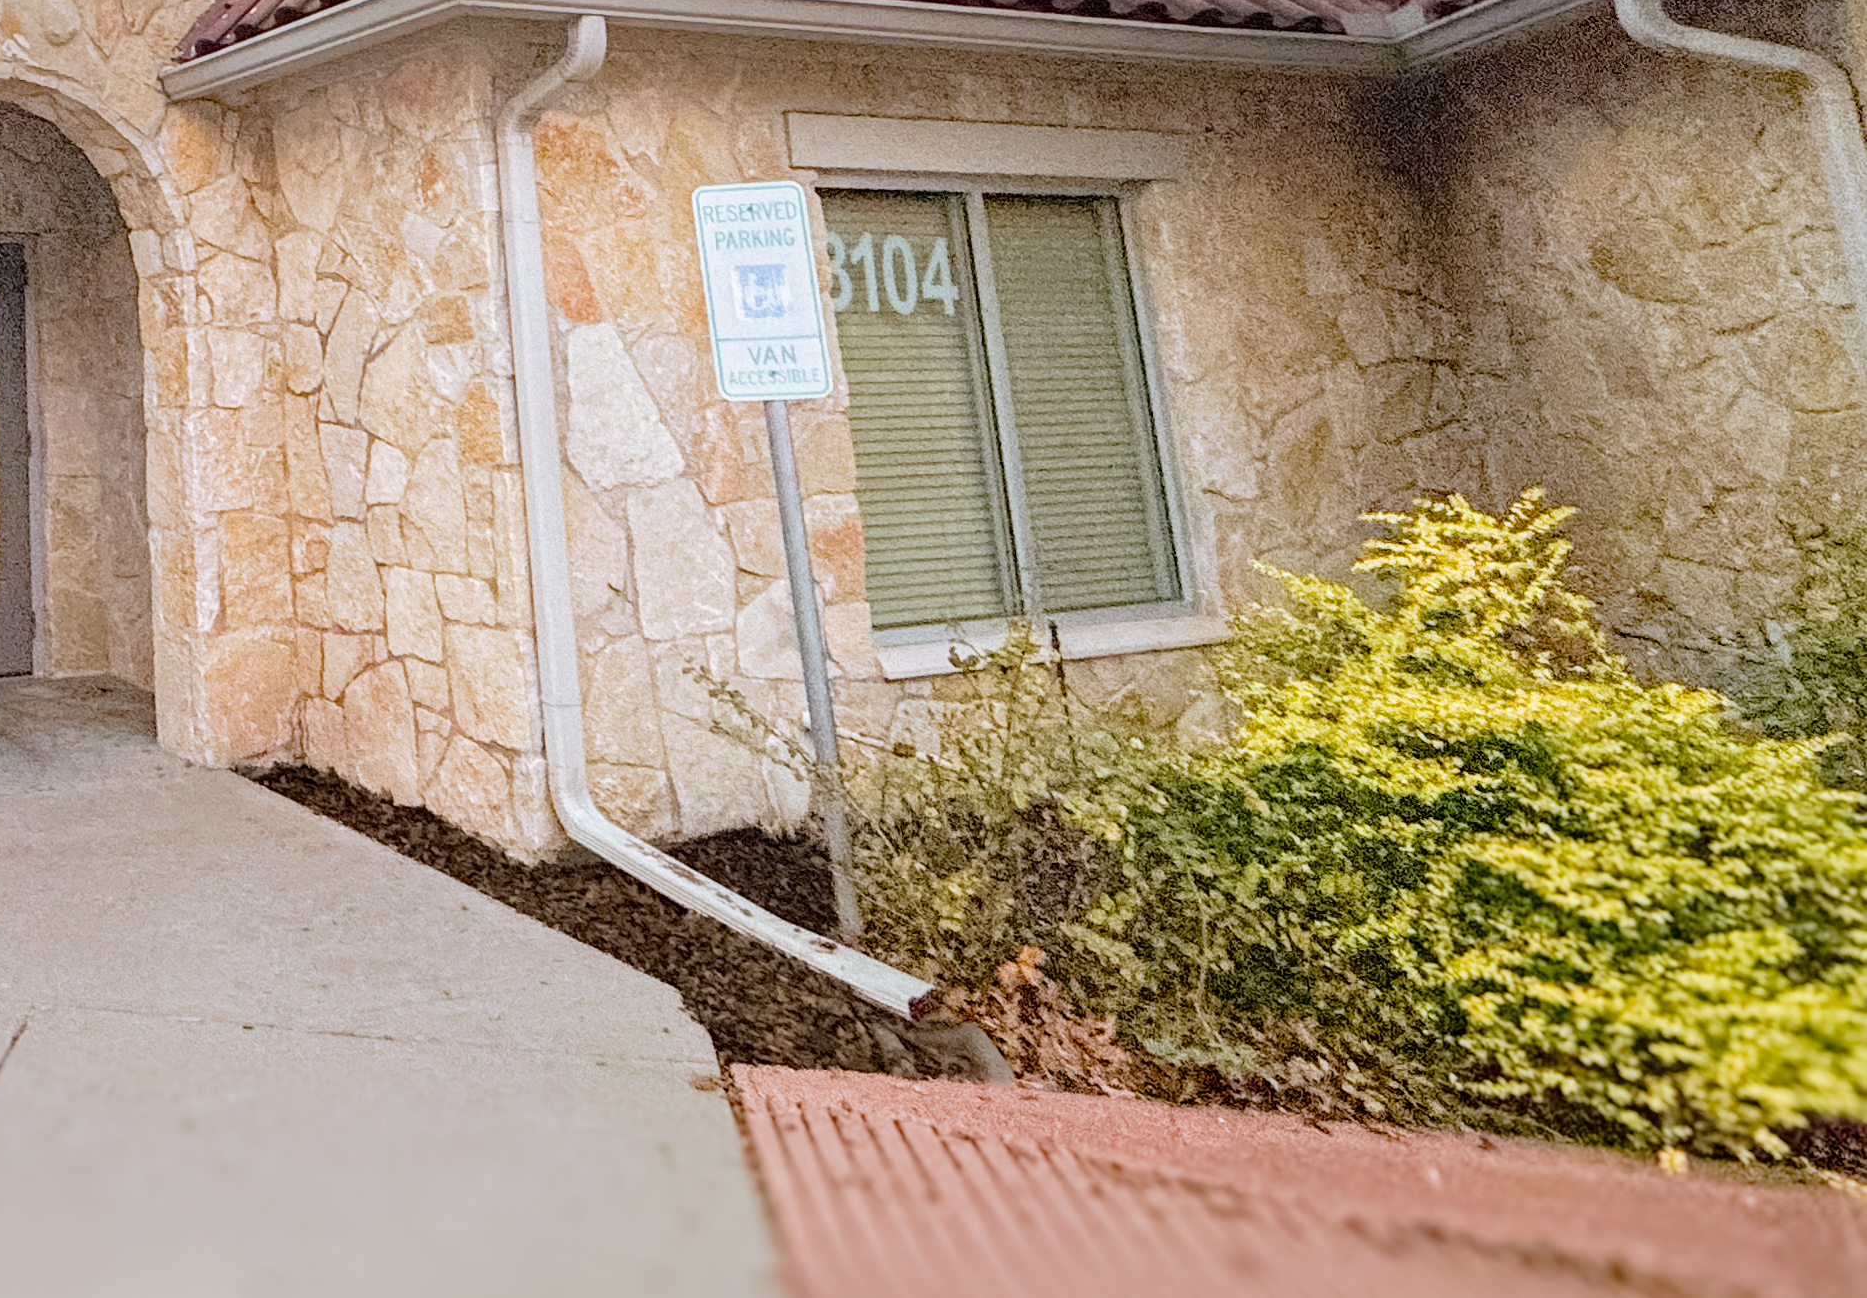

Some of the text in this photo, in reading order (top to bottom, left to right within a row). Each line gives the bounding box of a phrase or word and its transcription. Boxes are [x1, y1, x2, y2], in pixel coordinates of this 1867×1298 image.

[703, 201, 798, 224] RESERVED
[715, 228, 795, 251] PARKING
[748, 346, 797, 366] VAN
[730, 368, 822, 386] ACCESSIBLE
